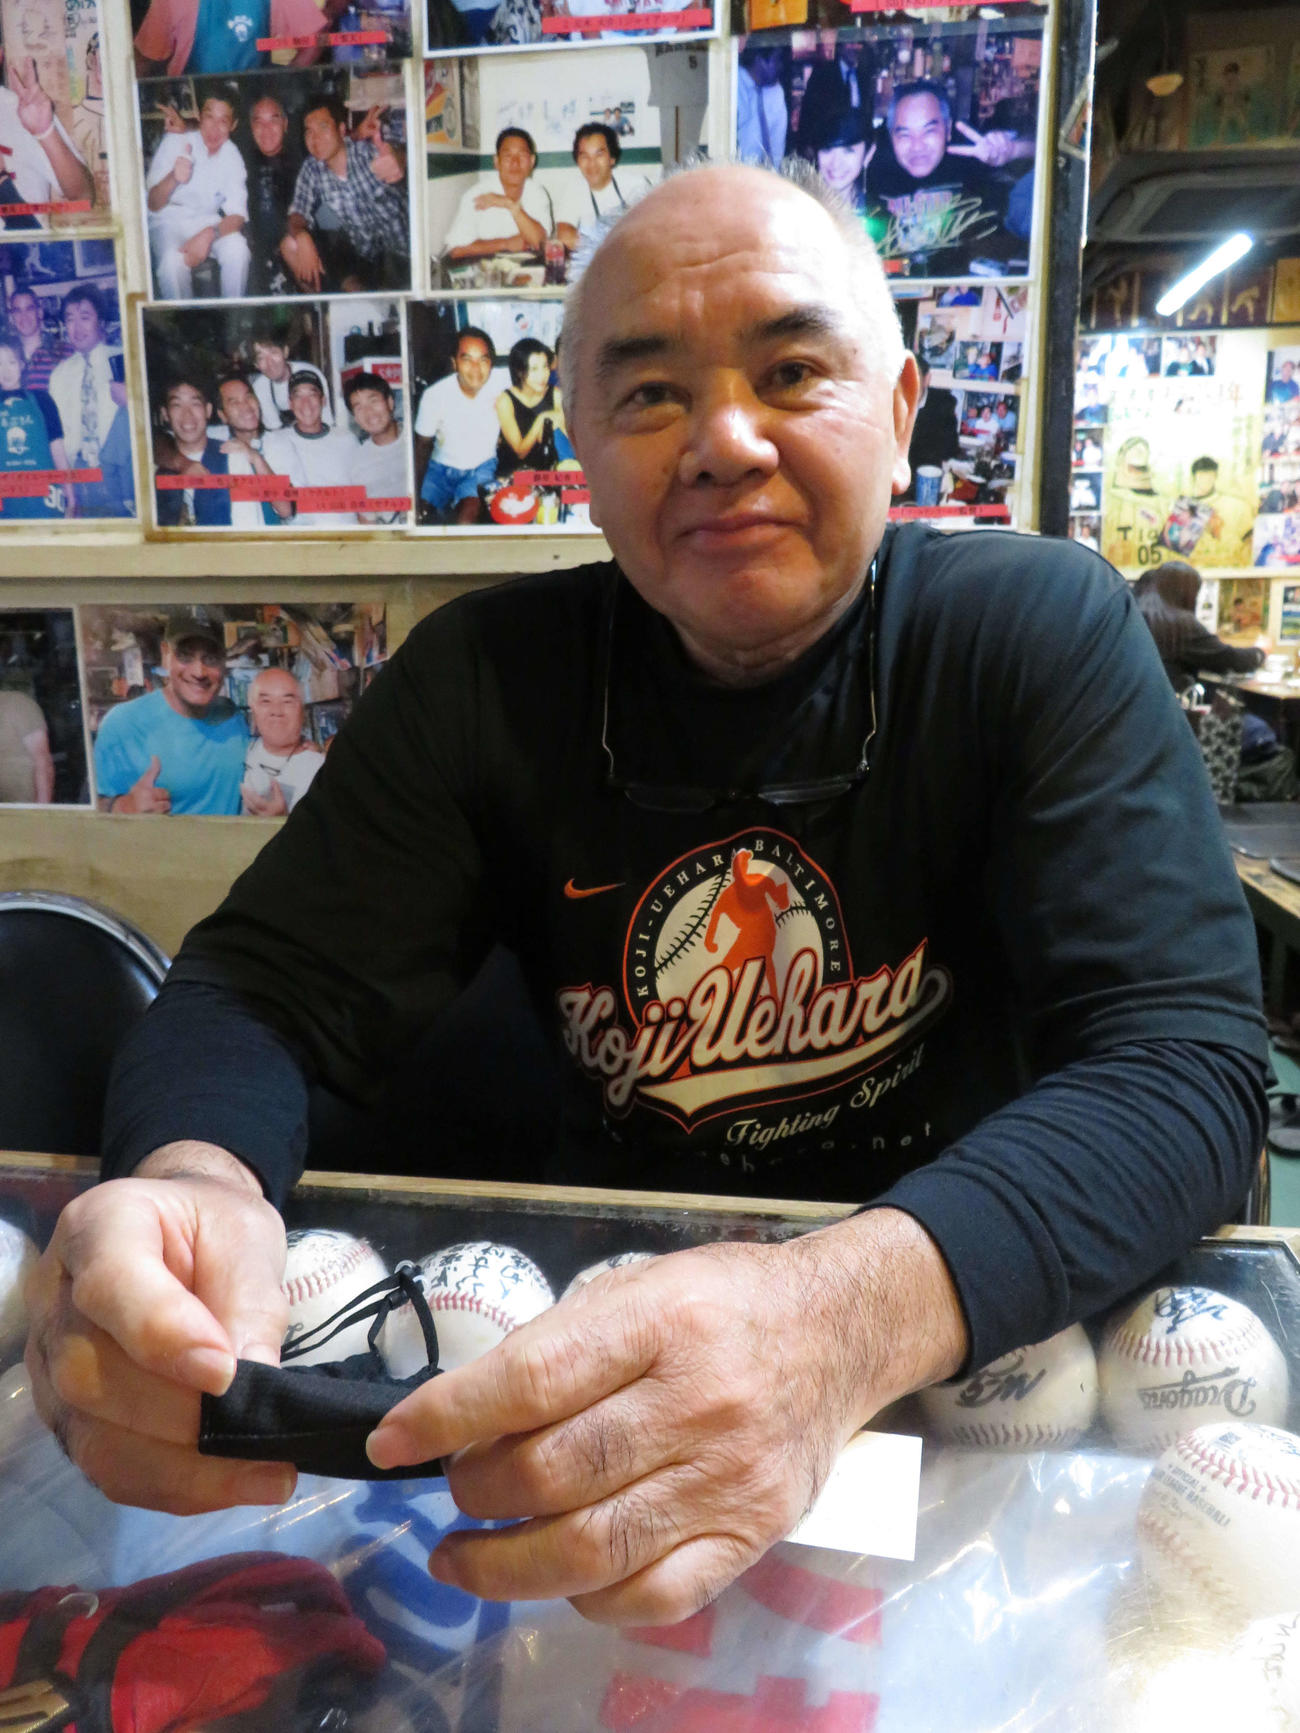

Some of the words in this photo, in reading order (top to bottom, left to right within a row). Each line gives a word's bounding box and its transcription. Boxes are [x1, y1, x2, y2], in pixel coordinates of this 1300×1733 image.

[754, 838, 842, 973] BALTIMORE
[556, 984, 689, 1108] Koji
[688, 936, 926, 1068] Uehara
[726, 1103, 840, 1149] Fighting
[850, 1043, 927, 1108] Spirit
[1136, 1367, 1257, 1418] Dragons
